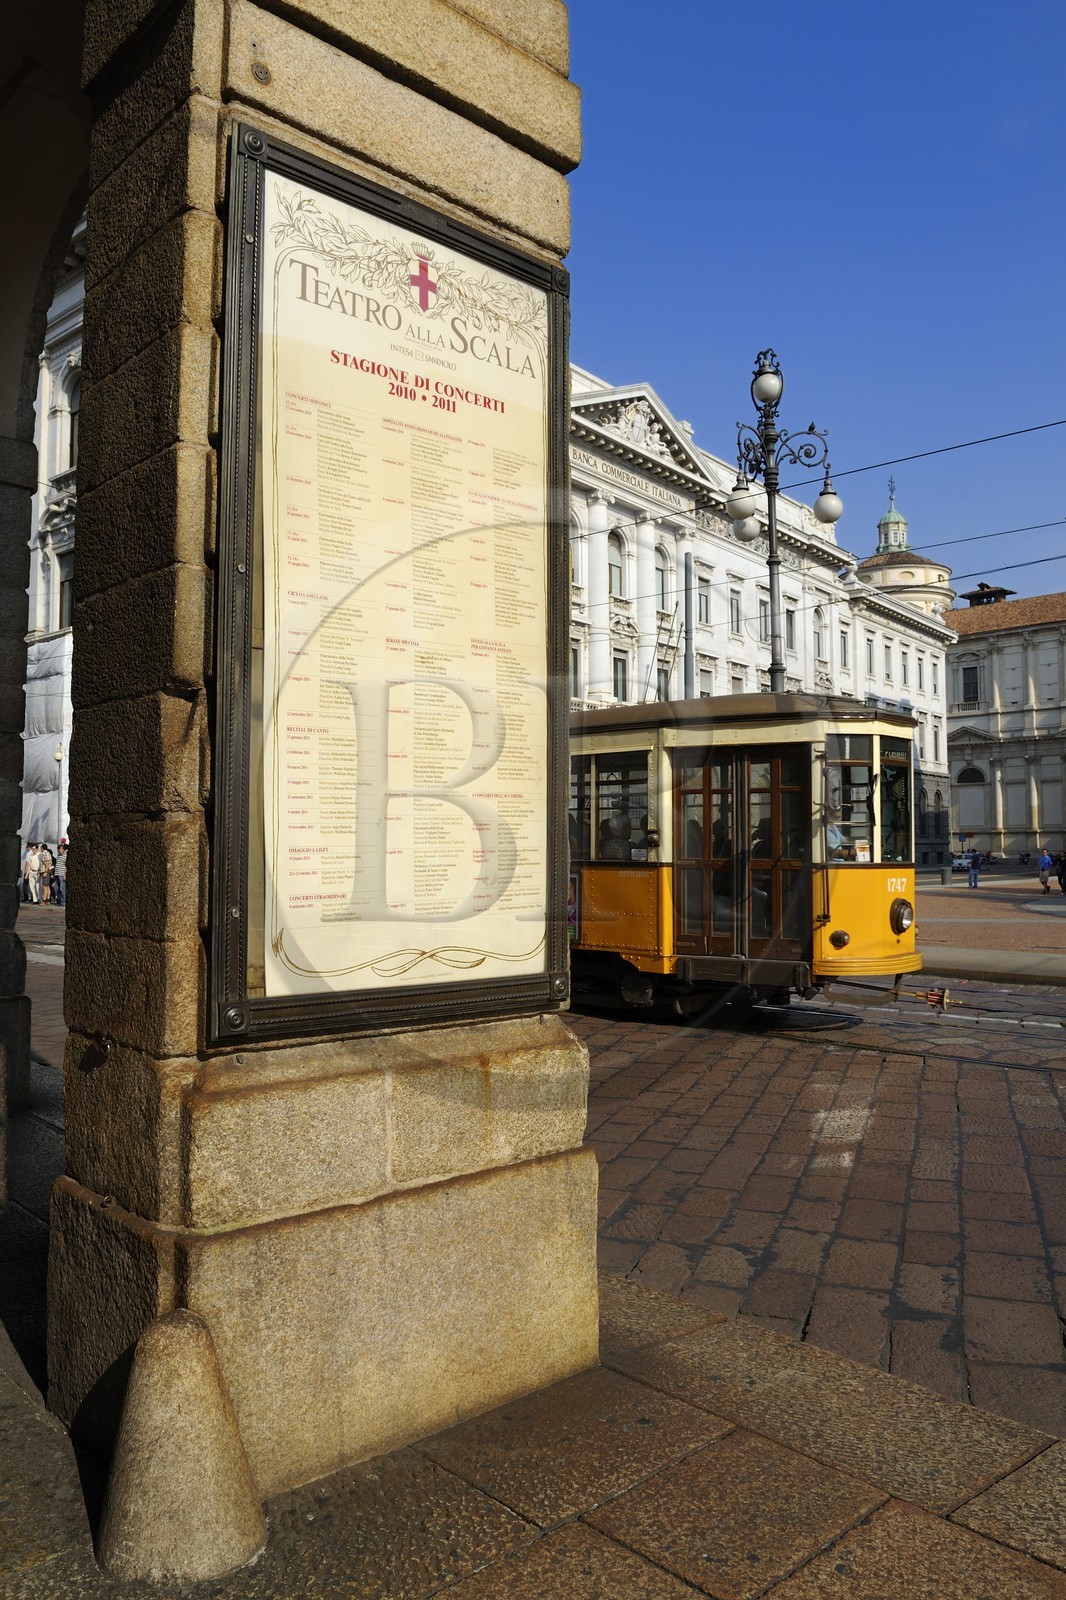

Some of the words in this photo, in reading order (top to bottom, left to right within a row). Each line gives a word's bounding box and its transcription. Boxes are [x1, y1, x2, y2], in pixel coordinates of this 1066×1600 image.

[290, 259, 402, 332] TEATRO
[404, 324, 446, 349] ALLA
[449, 317, 536, 379] SCALA
[390, 343, 413, 357] INTESA
[425, 354, 457, 371] SANPAOLO
[330, 350, 409, 385] STAGIONE
[414, 375, 430, 391] DI
[435, 382, 505, 413] CONCERTI
[388, 383, 416, 402] 2010
[432, 394, 456, 413] 2011
[572, 450, 598, 469] BANCA
[602, 464, 649, 492] COMMERCIALE
[652, 486, 681, 508] ITALIANA
[619, 869, 649, 878] entrata
[887, 878, 907, 892] 1747
